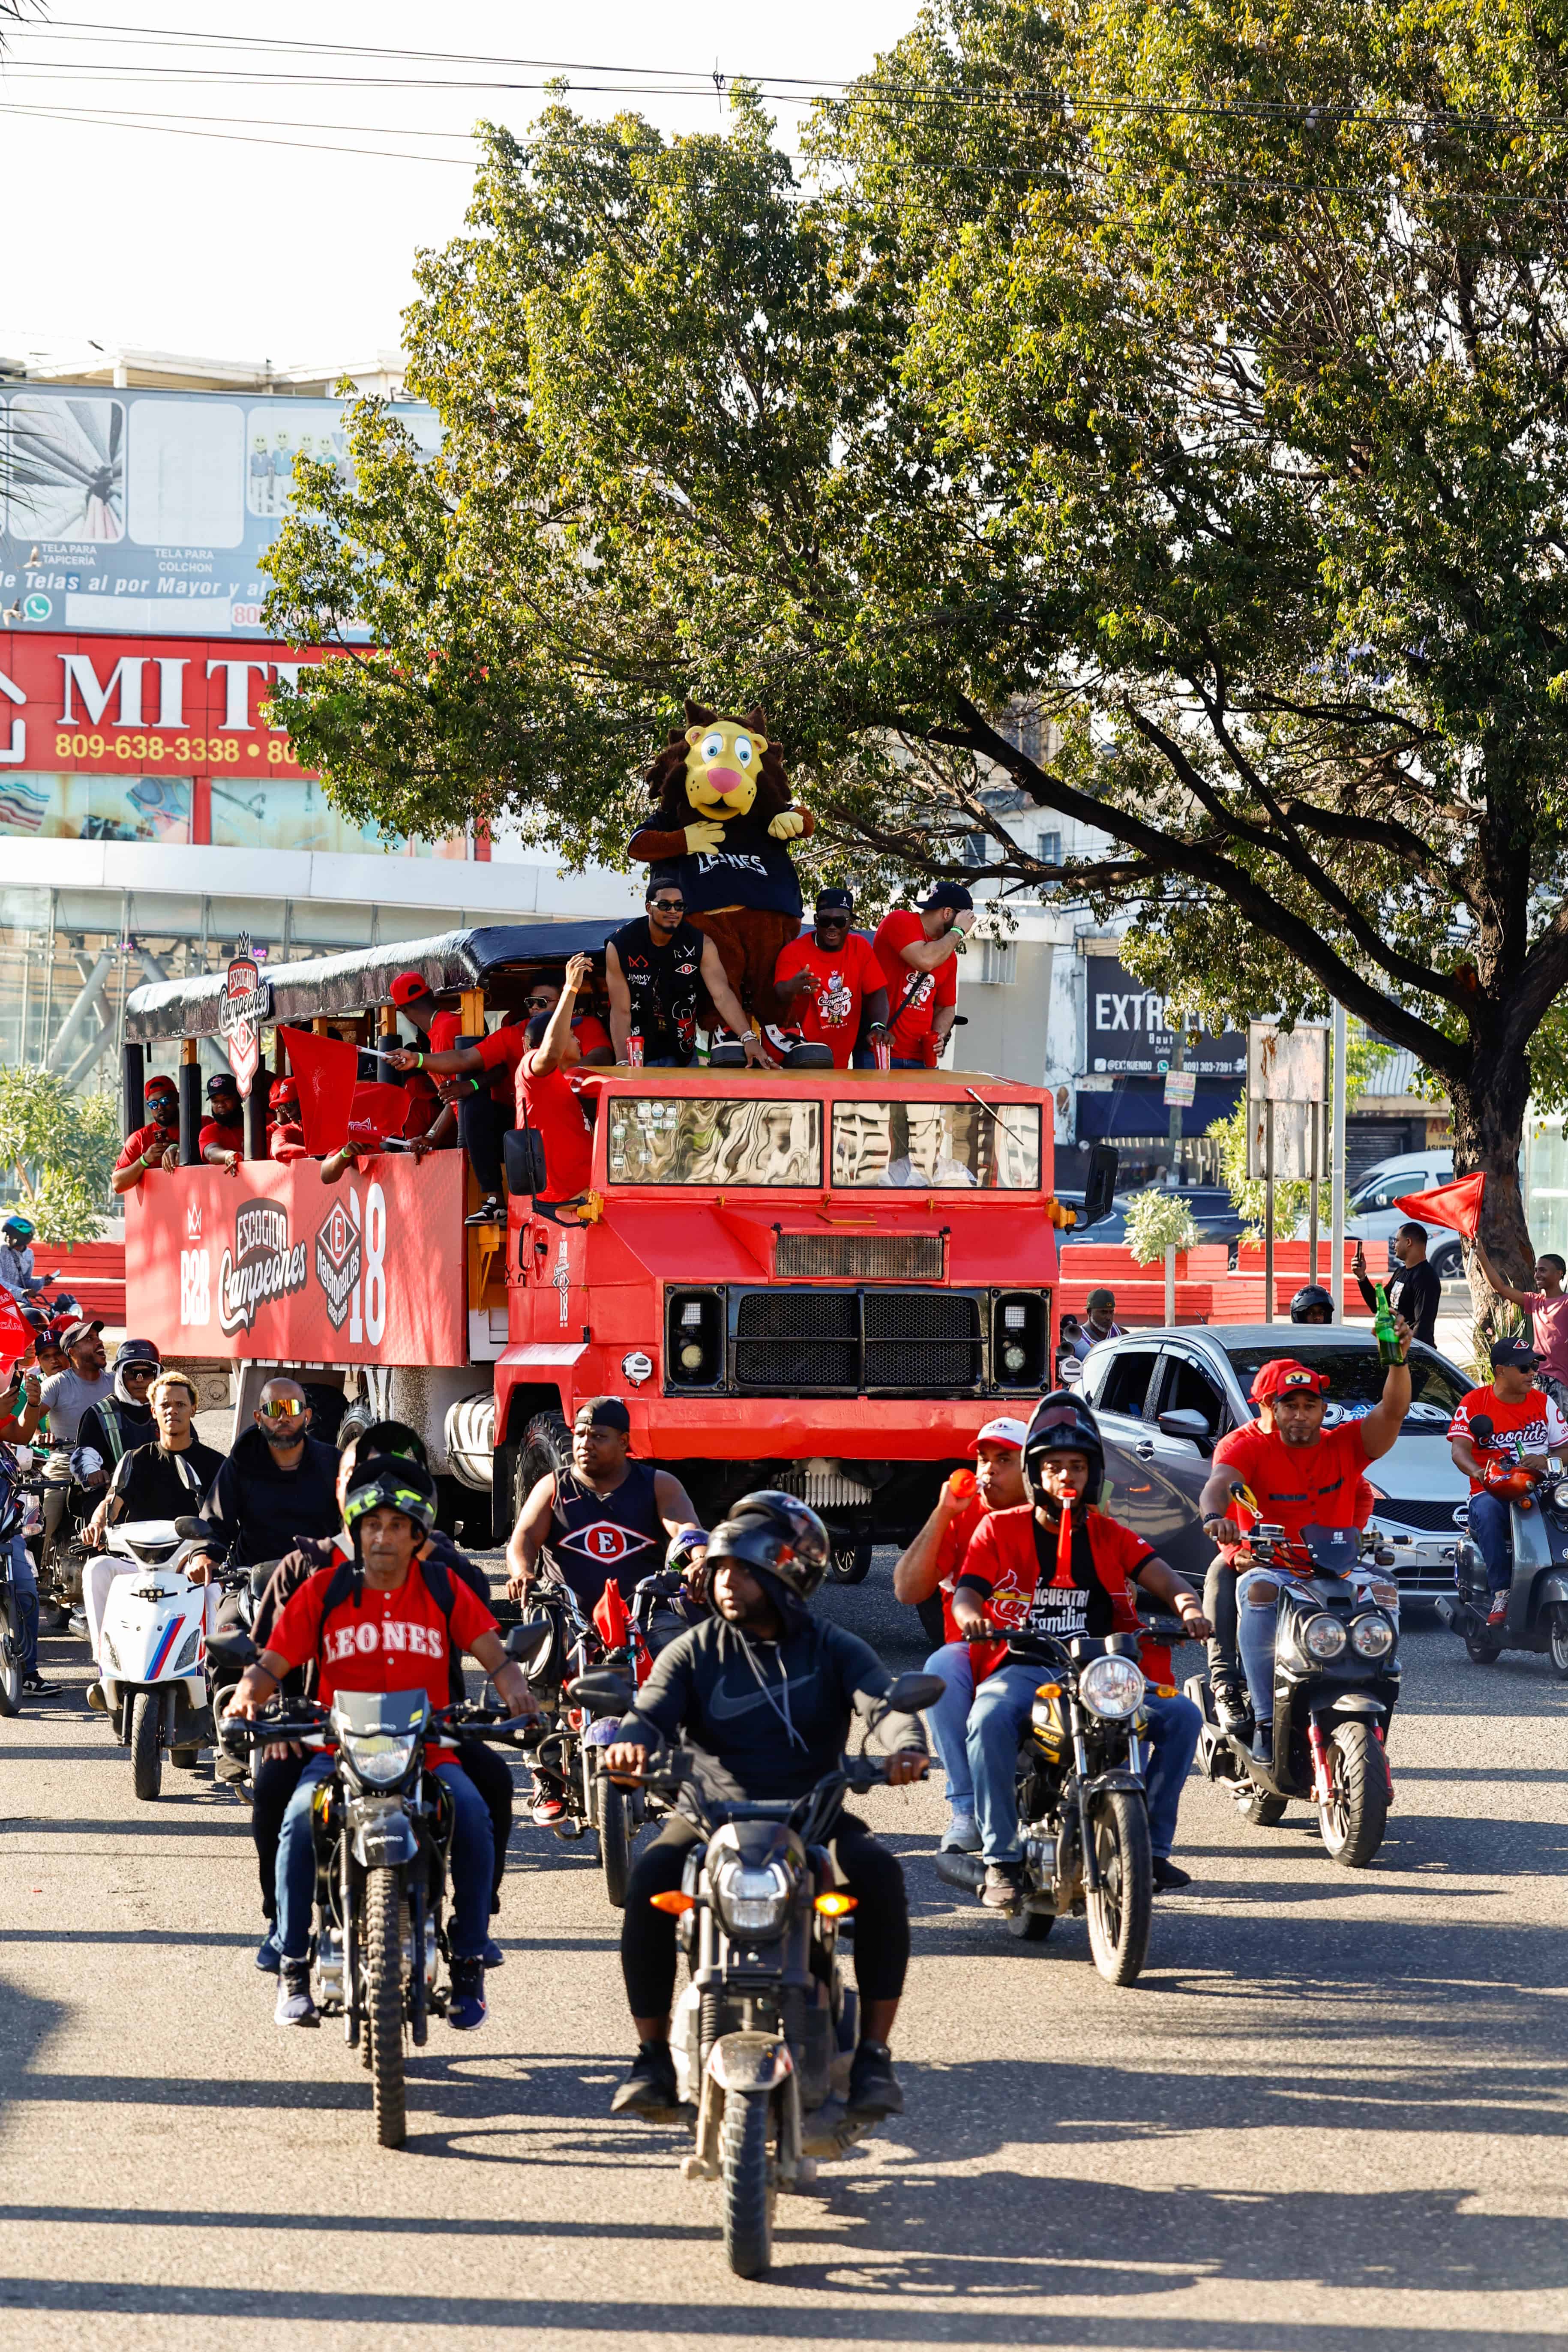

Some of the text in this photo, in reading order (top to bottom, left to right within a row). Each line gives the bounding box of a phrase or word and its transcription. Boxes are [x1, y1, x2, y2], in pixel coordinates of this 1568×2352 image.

[42, 543, 97, 554] TELA PARA
[154, 548, 214, 559] TELA PARA
[158, 561, 213, 573] COLCHON
[25, 571, 79, 590] Telas
[88, 574, 108, 591] al
[114, 578, 150, 595] por
[157, 577, 222, 597] Mayor
[229, 582, 240, 598] y
[246, 580, 267, 596] al
[55, 733, 240, 764] 809-638-3338
[229, 968, 256, 995] ESCOGIDO
[627, 973, 651, 981] JIMMY
[219, 986, 268, 1033] Campeones
[817, 992, 852, 1007] Campeones
[237, 1210, 287, 1259] ESCOGIDO
[335, 1216, 342, 1252] E
[180, 1249, 210, 1325] B2B
[218, 1242, 306, 1330] Campeones
[1451, 1423, 1468, 1432] altice
[597, 1531, 617, 1553] E
[324, 1620, 444, 1665] LEONES
